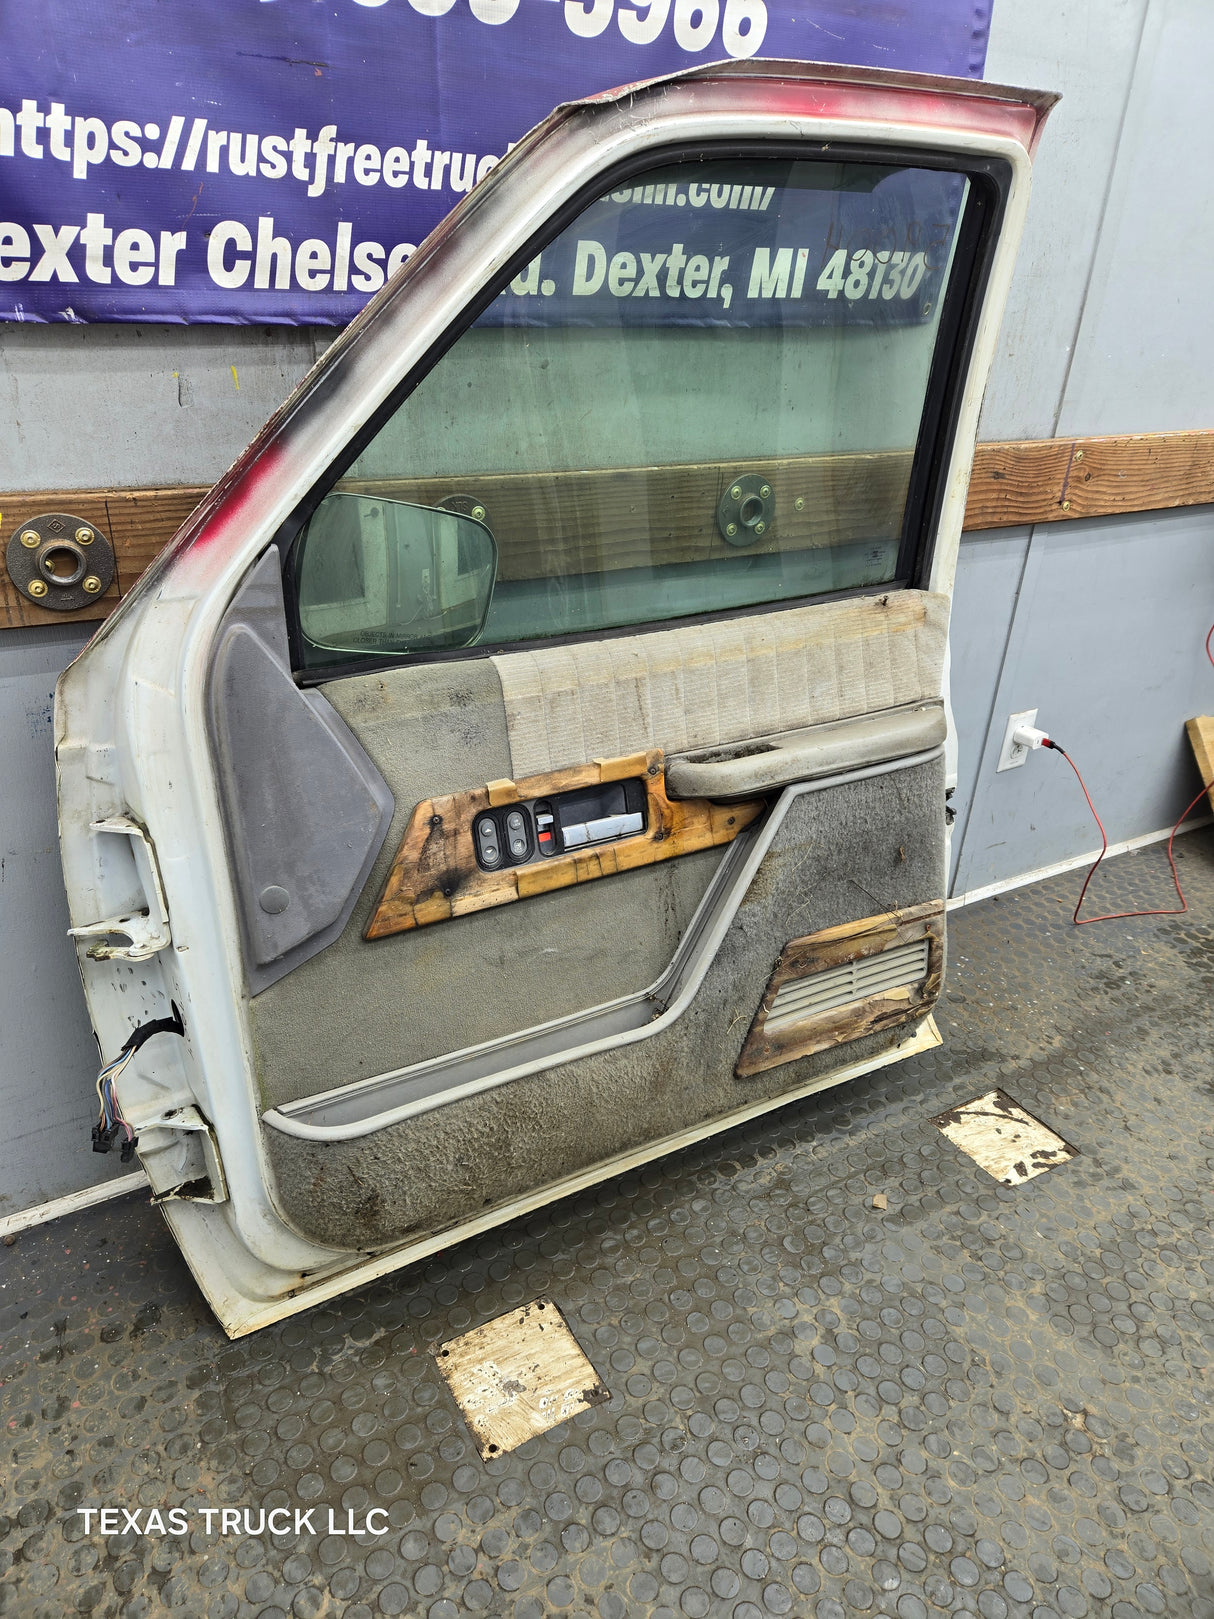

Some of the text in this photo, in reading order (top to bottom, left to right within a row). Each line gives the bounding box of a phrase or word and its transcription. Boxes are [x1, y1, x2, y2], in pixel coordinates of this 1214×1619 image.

[0, 99, 516, 197] ttps://rustfreetru
[500, 253, 556, 296] d.
[572, 239, 735, 309] Dexter,
[746, 247, 810, 299] MI
[816, 248, 926, 300] 48130
